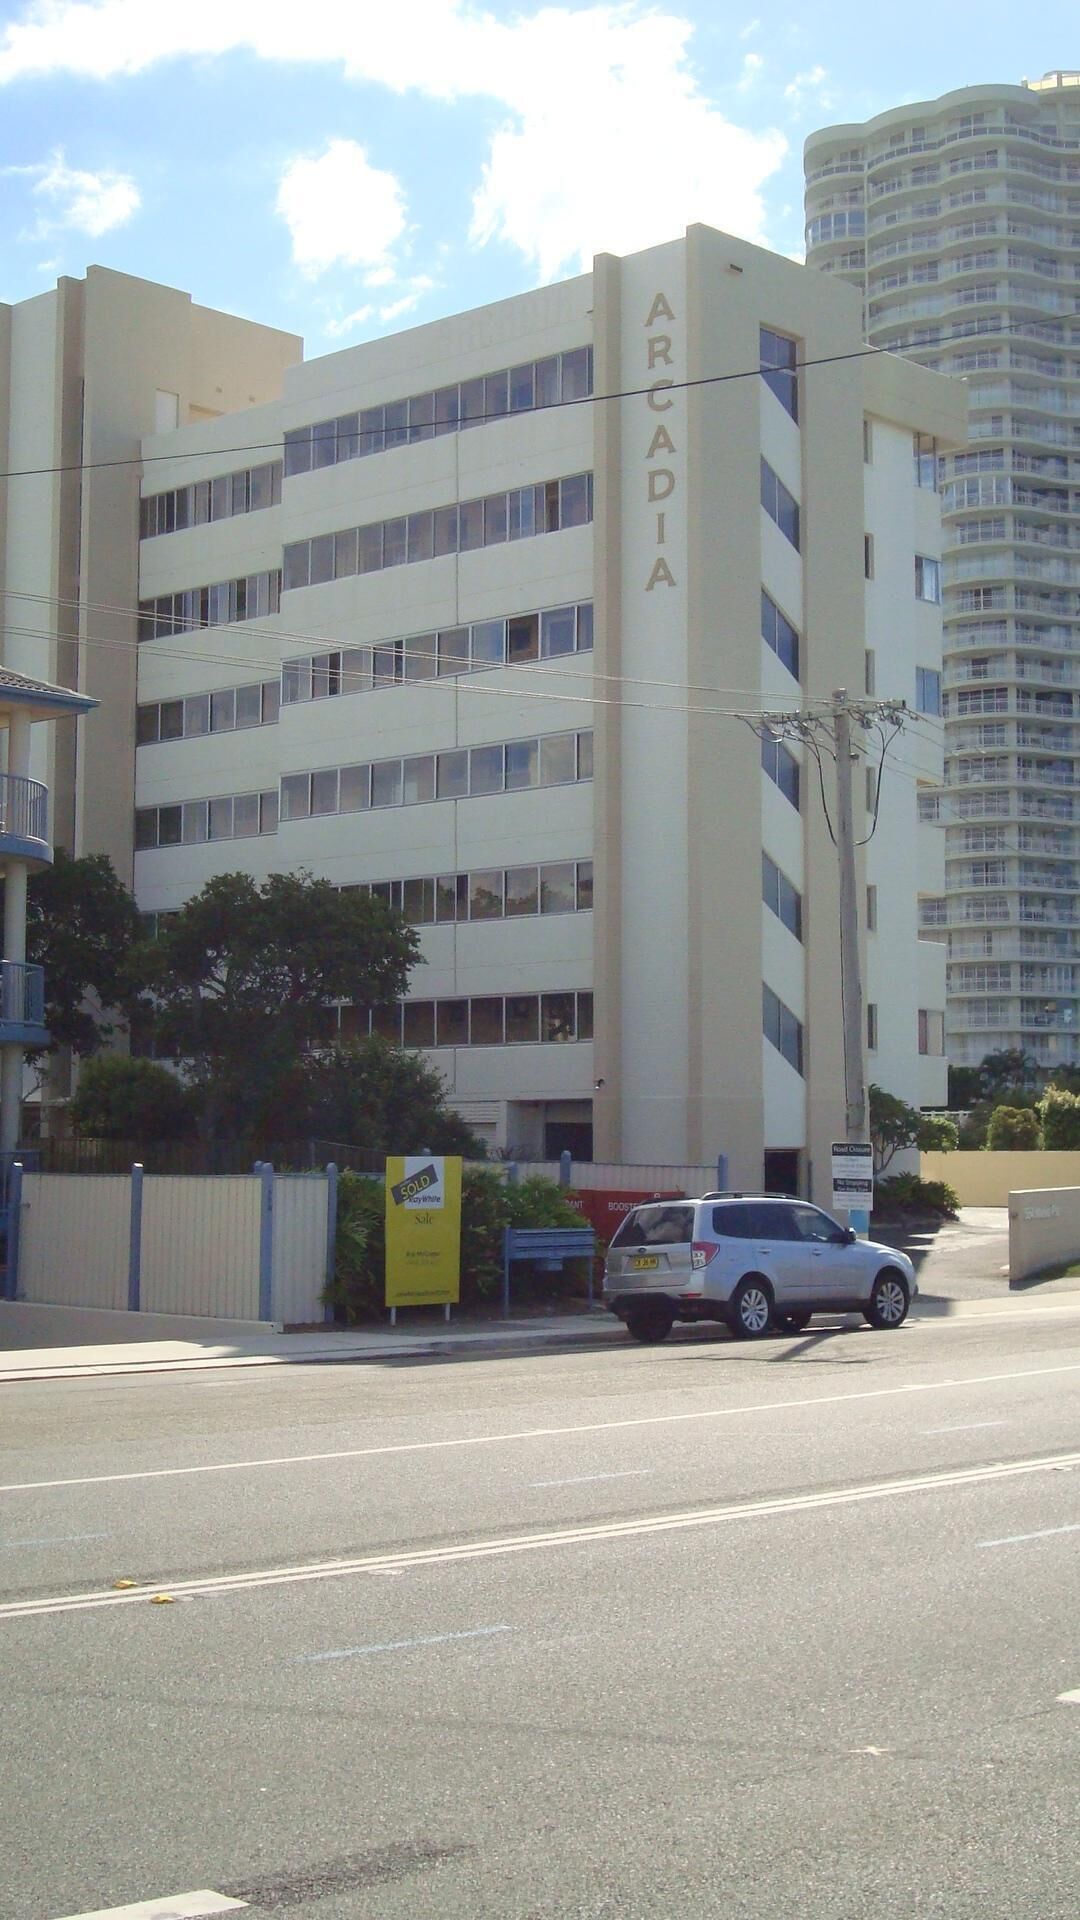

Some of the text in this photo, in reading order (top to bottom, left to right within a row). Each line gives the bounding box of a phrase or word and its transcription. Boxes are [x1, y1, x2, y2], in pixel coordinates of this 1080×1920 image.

[644, 292, 677, 592] ARCADIA
[400, 1175, 430, 1200] SOLD
[608, 1202, 640, 1211] BOOST
[415, 1212, 434, 1225] Sale
